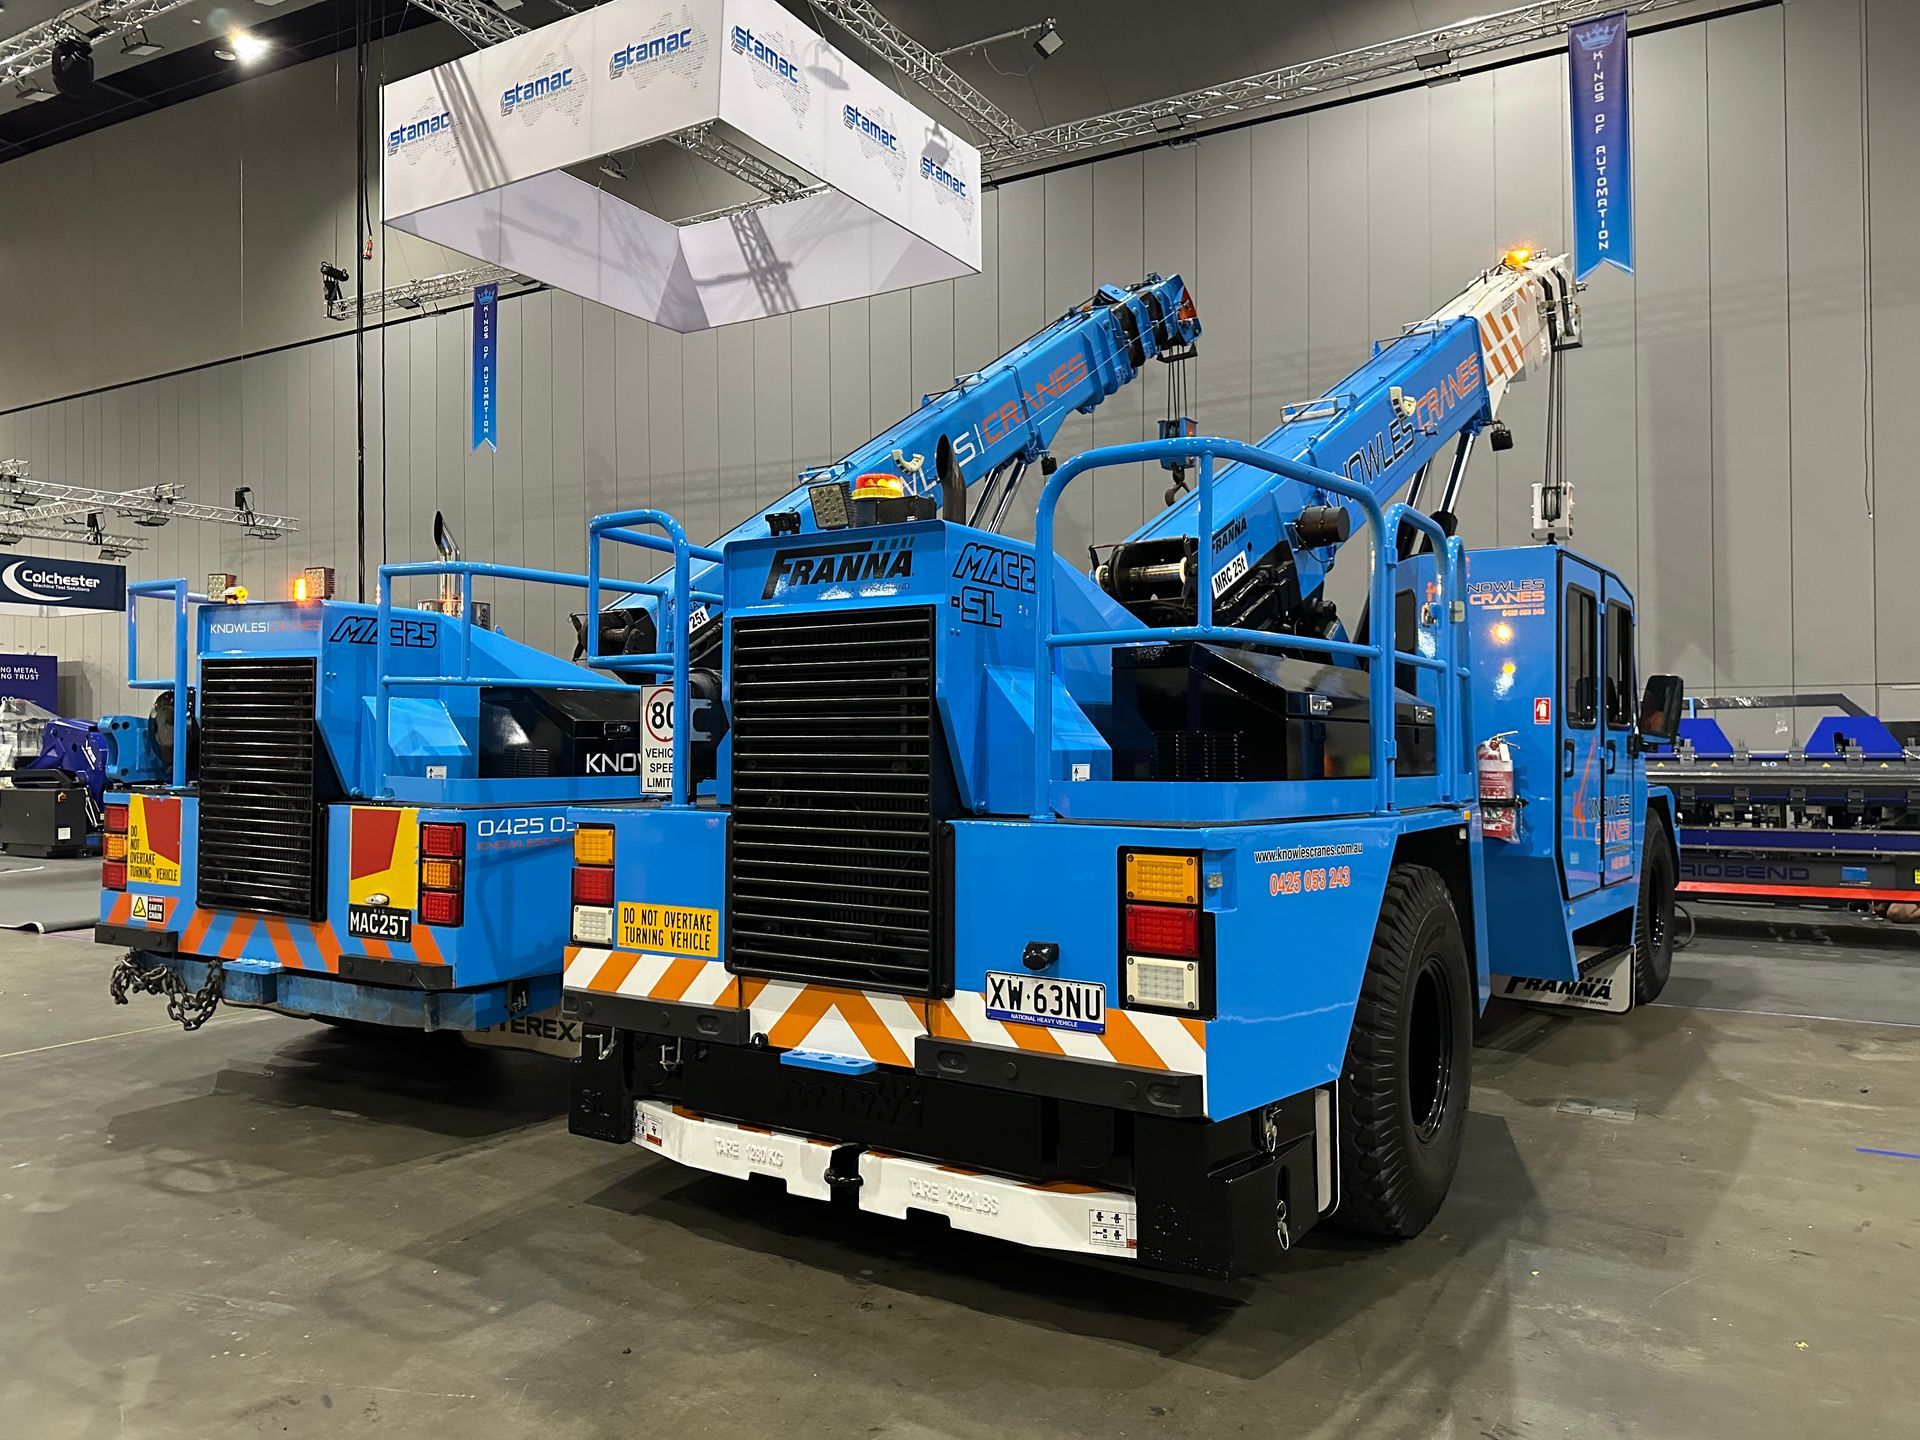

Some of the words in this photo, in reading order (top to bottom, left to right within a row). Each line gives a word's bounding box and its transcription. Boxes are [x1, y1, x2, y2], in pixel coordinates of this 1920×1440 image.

[613, 28, 692, 70] stamac
[736, 25, 798, 84] stamac
[503, 67, 573, 107] stamac
[1593, 50, 1605, 103] KINGS
[389, 111, 450, 147] stamac
[847, 104, 897, 151] stamac
[1595, 114, 1605, 134] OF
[921, 156, 966, 197] stamac
[1596, 145, 1609, 251] AUTOMATION
[483, 346, 489, 360] OF
[1416, 352, 1481, 429] CRANES
[22, 570, 101, 589] Colchester
[761, 540, 914, 600] FRANNA
[952, 541, 1036, 595] MAC2
[1214, 566, 1233, 593] MRC
[1232, 556, 1246, 578] 25t
[33, 582, 54, 590] Machine
[1466, 578, 1545, 594] NOWLES
[1469, 590, 1546, 605] CRANES
[210, 622, 267, 635] KNOWLES
[645, 747, 673, 759] VEHIC
[649, 762, 673, 773] SPEE
[646, 777, 673, 788] LIMIT
[130, 825, 138, 838] DO
[477, 817, 544, 837] 0425
[130, 838, 140, 851] NOT
[1254, 842, 1363, 863] www.knowlescranes.com.au
[130, 852, 156, 866] OVERTAKE
[130, 865, 152, 879] TURNING
[156, 867, 178, 882] VEHICLE
[1269, 870, 1301, 897] 0425
[1304, 868, 1327, 892] 053
[1328, 865, 1350, 888] 243
[350, 911, 409, 937] MAC25T
[623, 907, 635, 924] DO
[641, 909, 659, 927] NOT
[664, 910, 712, 932] OVERTAKE
[624, 926, 664, 946] TURNING
[670, 931, 711, 951] VEHICLE
[1503, 976, 1612, 1000] FRANNA
[1588, 999, 1609, 1007] BRAND
[1010, 1012, 1036, 1022] NATIONAL
[1036, 1016, 1056, 1025] HEAVY
[1056, 1019, 1078, 1028] VEHICLE
[714, 1136, 740, 1160] TARE
[908, 1177, 940, 1203] TARE
